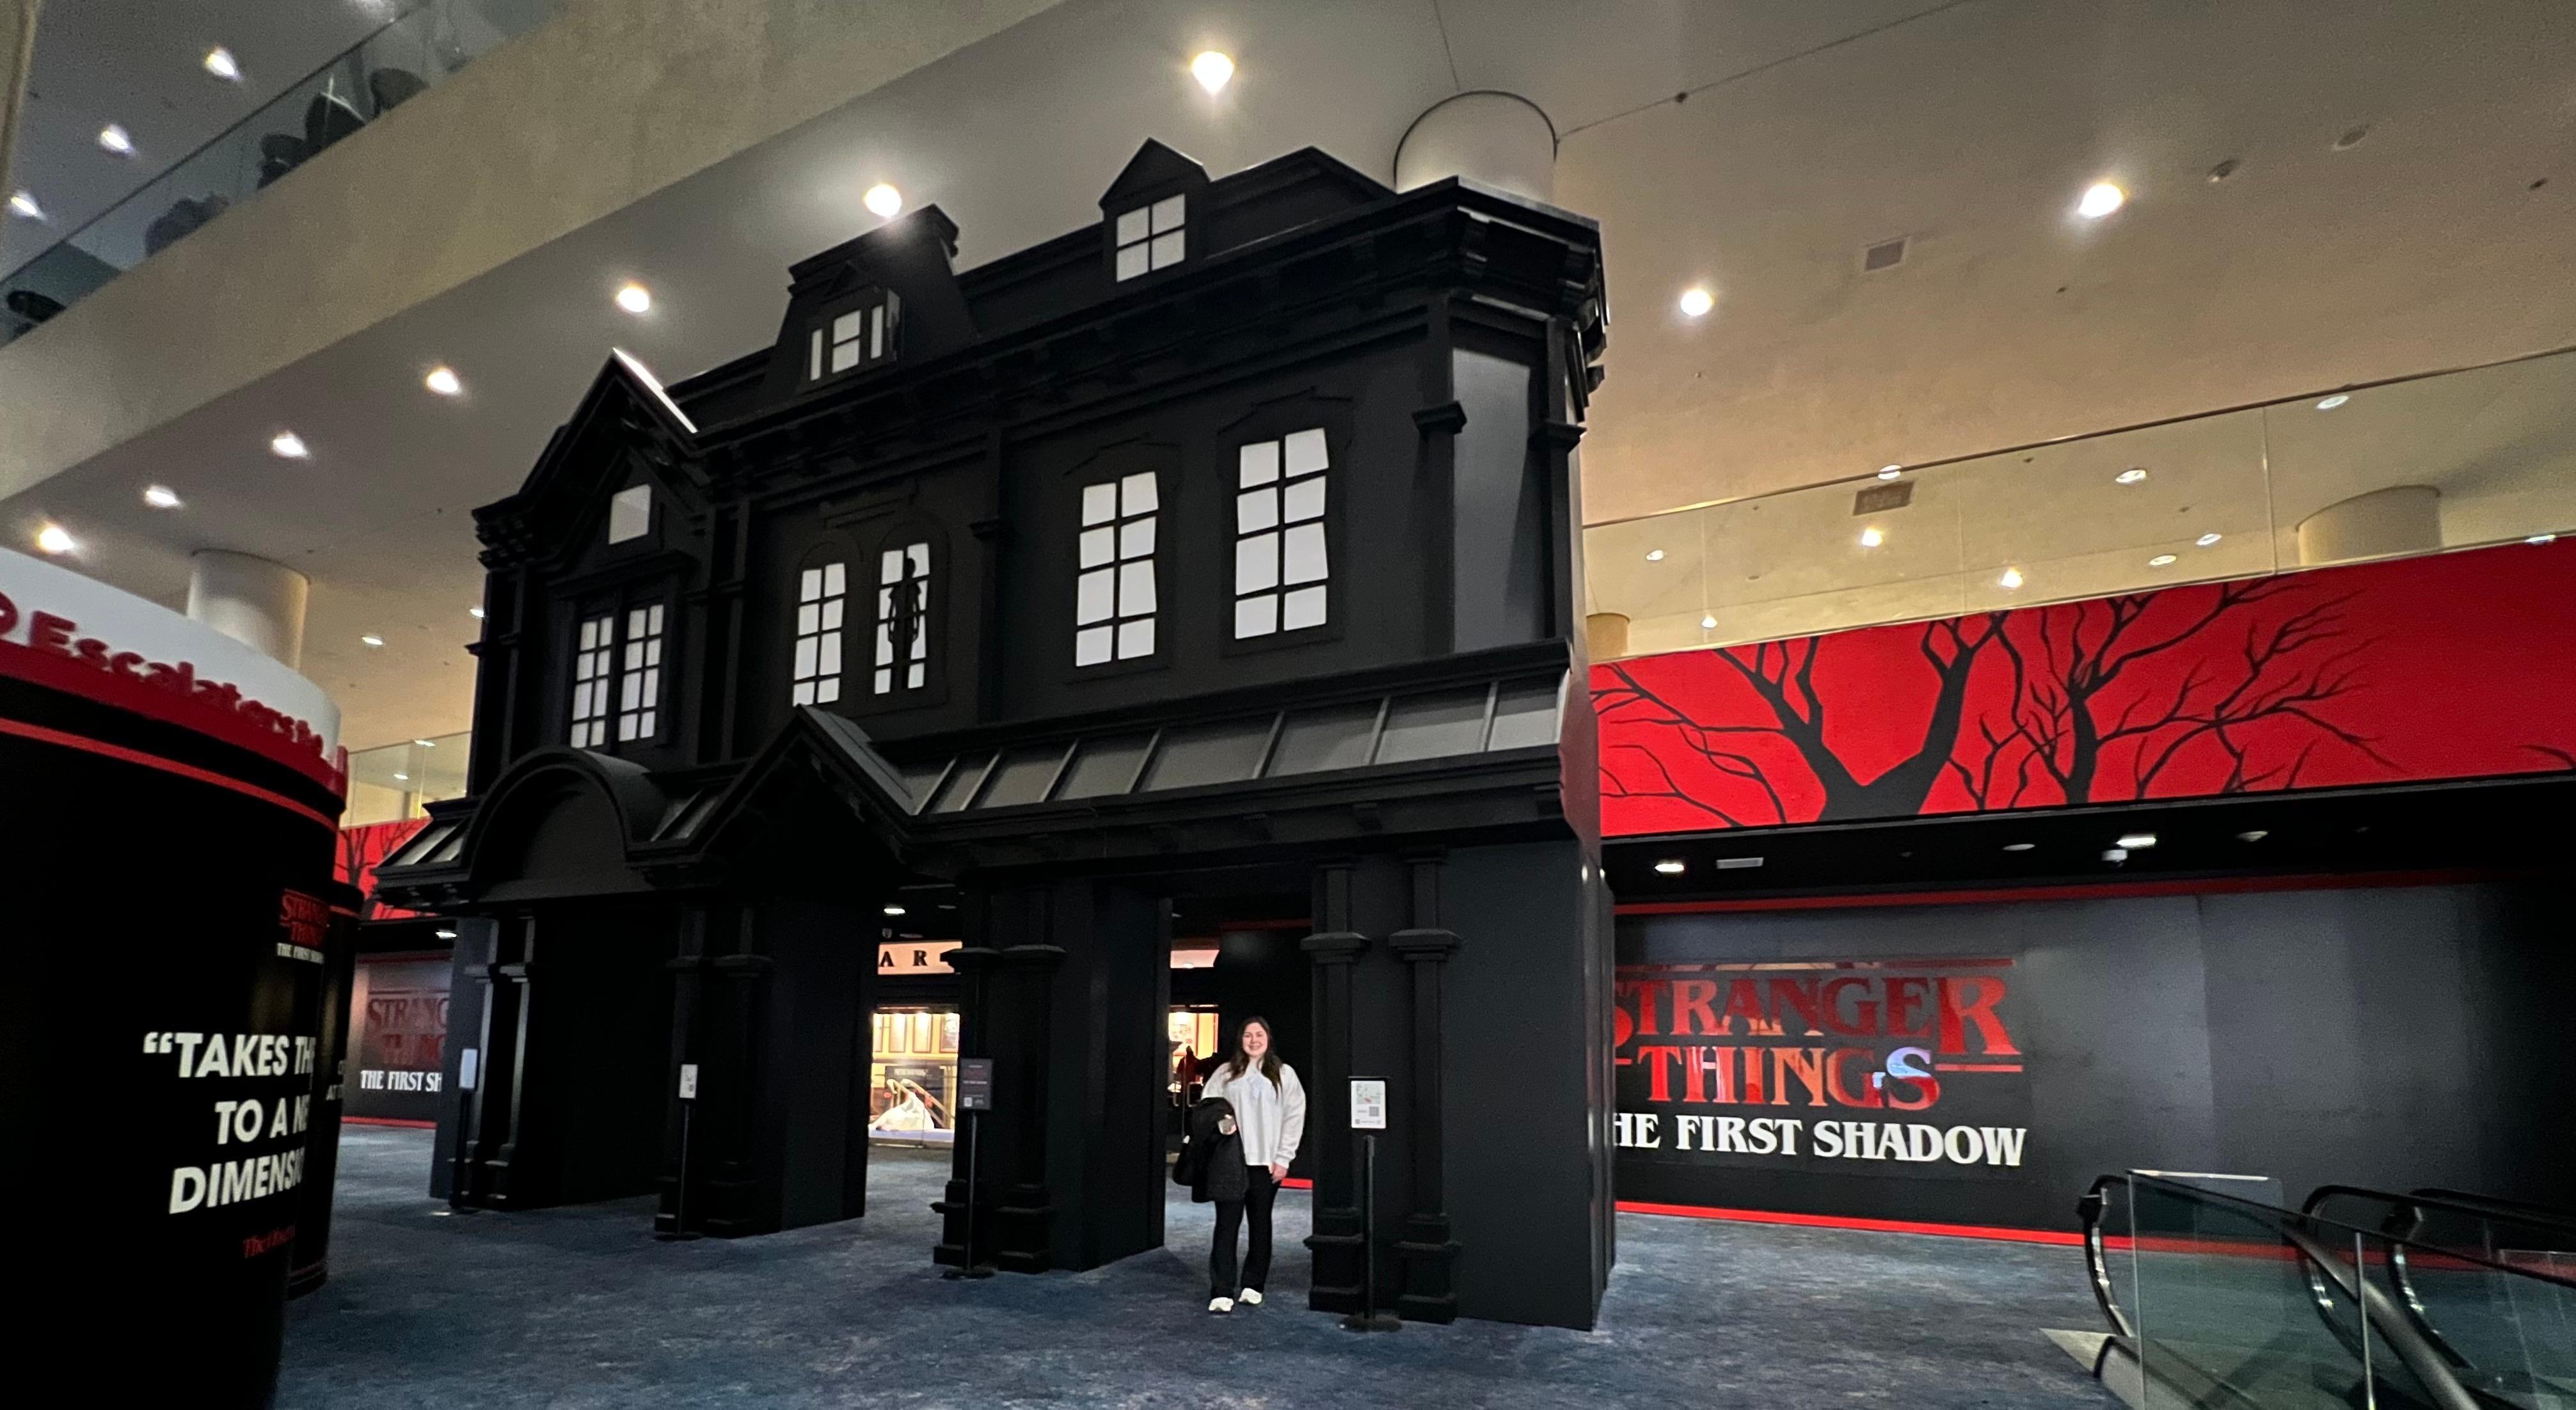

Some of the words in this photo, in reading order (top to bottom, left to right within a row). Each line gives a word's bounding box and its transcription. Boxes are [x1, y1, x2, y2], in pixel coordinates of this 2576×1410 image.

[360, 1069, 385, 1089] THE
[387, 1070, 425, 1092] FIRST
[425, 1072, 443, 1093] SH
[1637, 1045, 1941, 1111] THINGS
[214, 1098, 264, 1145] TO
[269, 1097, 288, 1139] A
[1613, 1112, 1661, 1149] HE
[1675, 1114, 1803, 1155] FIRST
[1813, 1120, 2027, 1166] SHADOW
